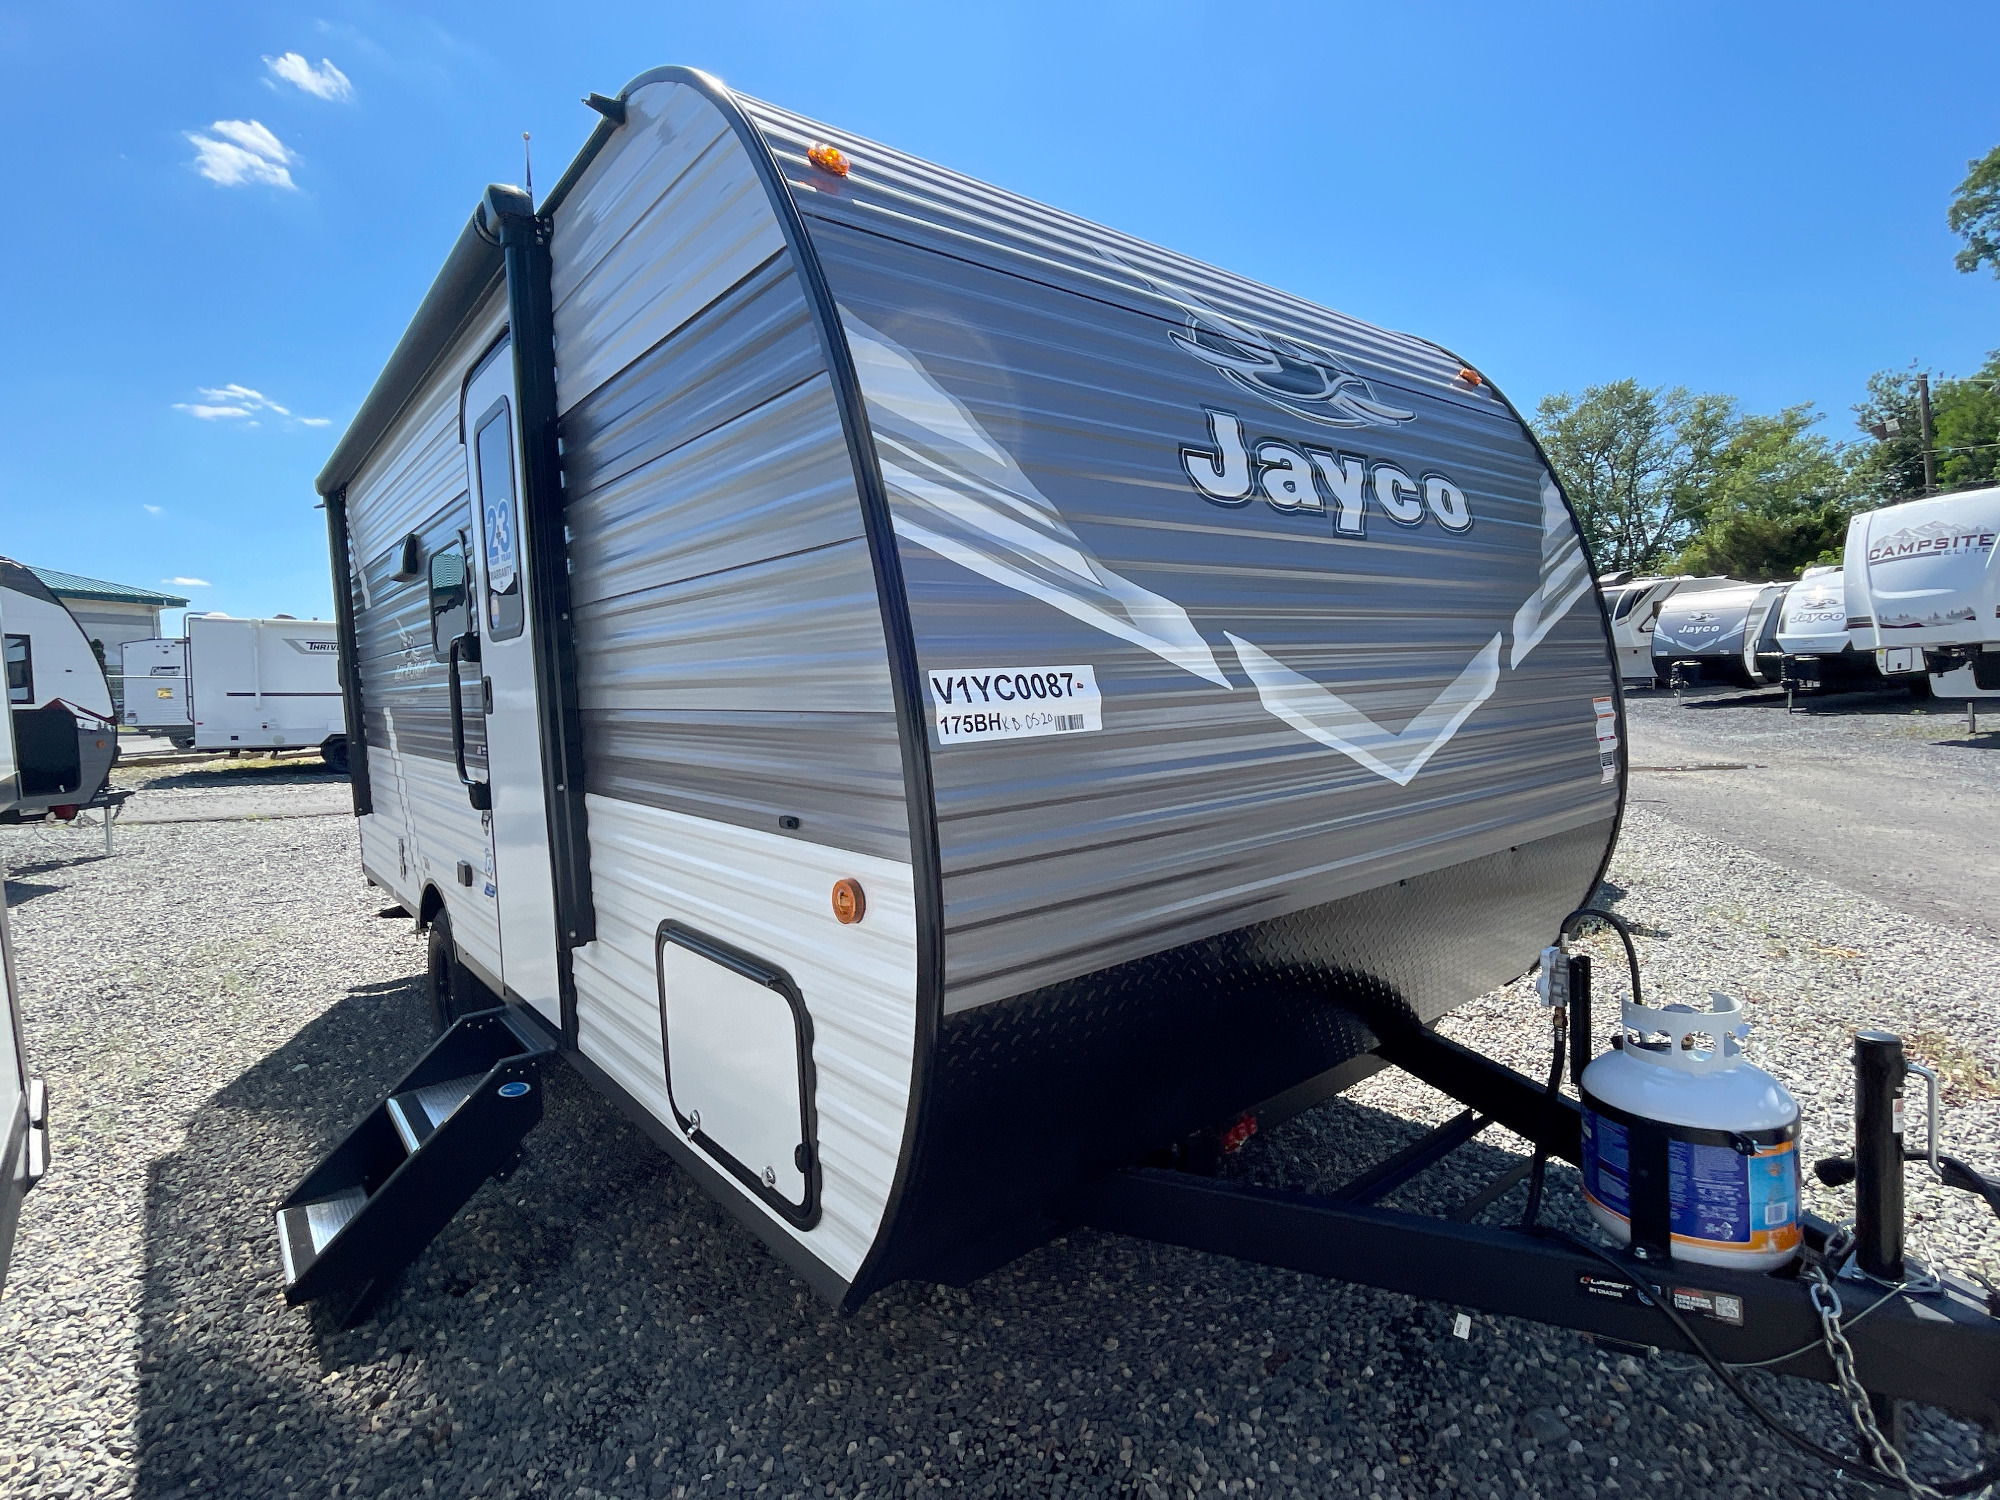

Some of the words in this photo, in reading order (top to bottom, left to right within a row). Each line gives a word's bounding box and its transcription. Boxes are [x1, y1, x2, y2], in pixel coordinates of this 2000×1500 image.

[1179, 404, 1475, 539] Jayco
[1869, 533, 1995, 561] CAMPSITE
[1943, 546, 1990, 556] ELITE
[490, 565, 513, 581] WARRANTY
[1790, 611, 1845, 623] Jayco
[1678, 624, 1720, 634] Jayco
[306, 641, 339, 651] THRIV
[932, 673, 1073, 704] V1YC0087
[940, 713, 1001, 735] 175BH
